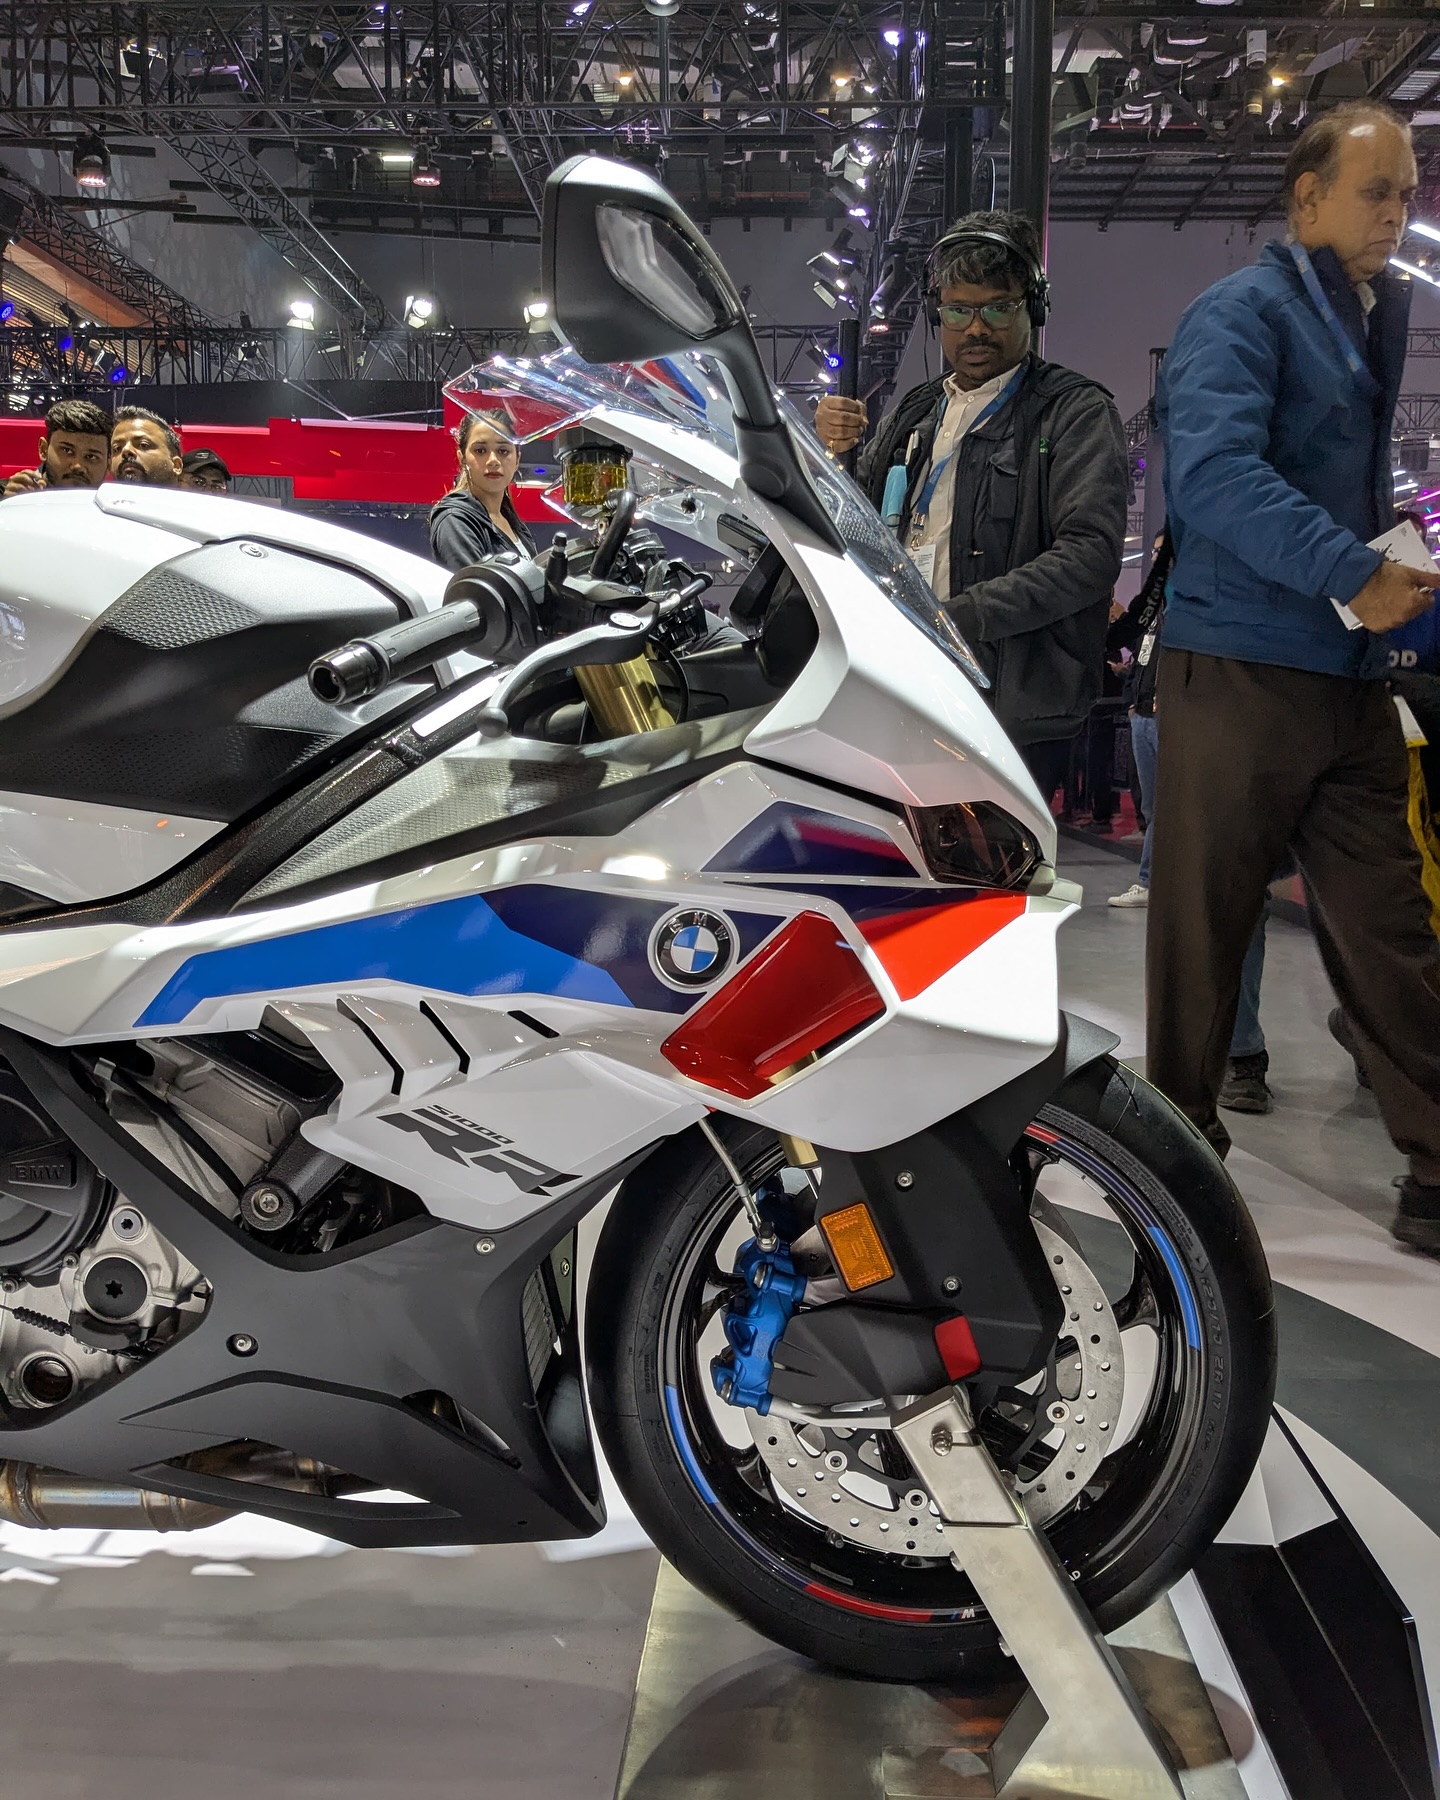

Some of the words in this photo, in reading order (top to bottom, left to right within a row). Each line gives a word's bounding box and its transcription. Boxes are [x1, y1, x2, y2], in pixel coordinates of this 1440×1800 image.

[668, 911, 729, 941] BMW
[427, 1104, 515, 1145] S1000
[376, 1108, 583, 1197] RR
[15, 1164, 65, 1180] BMW
[961, 1608, 976, 1619] M
